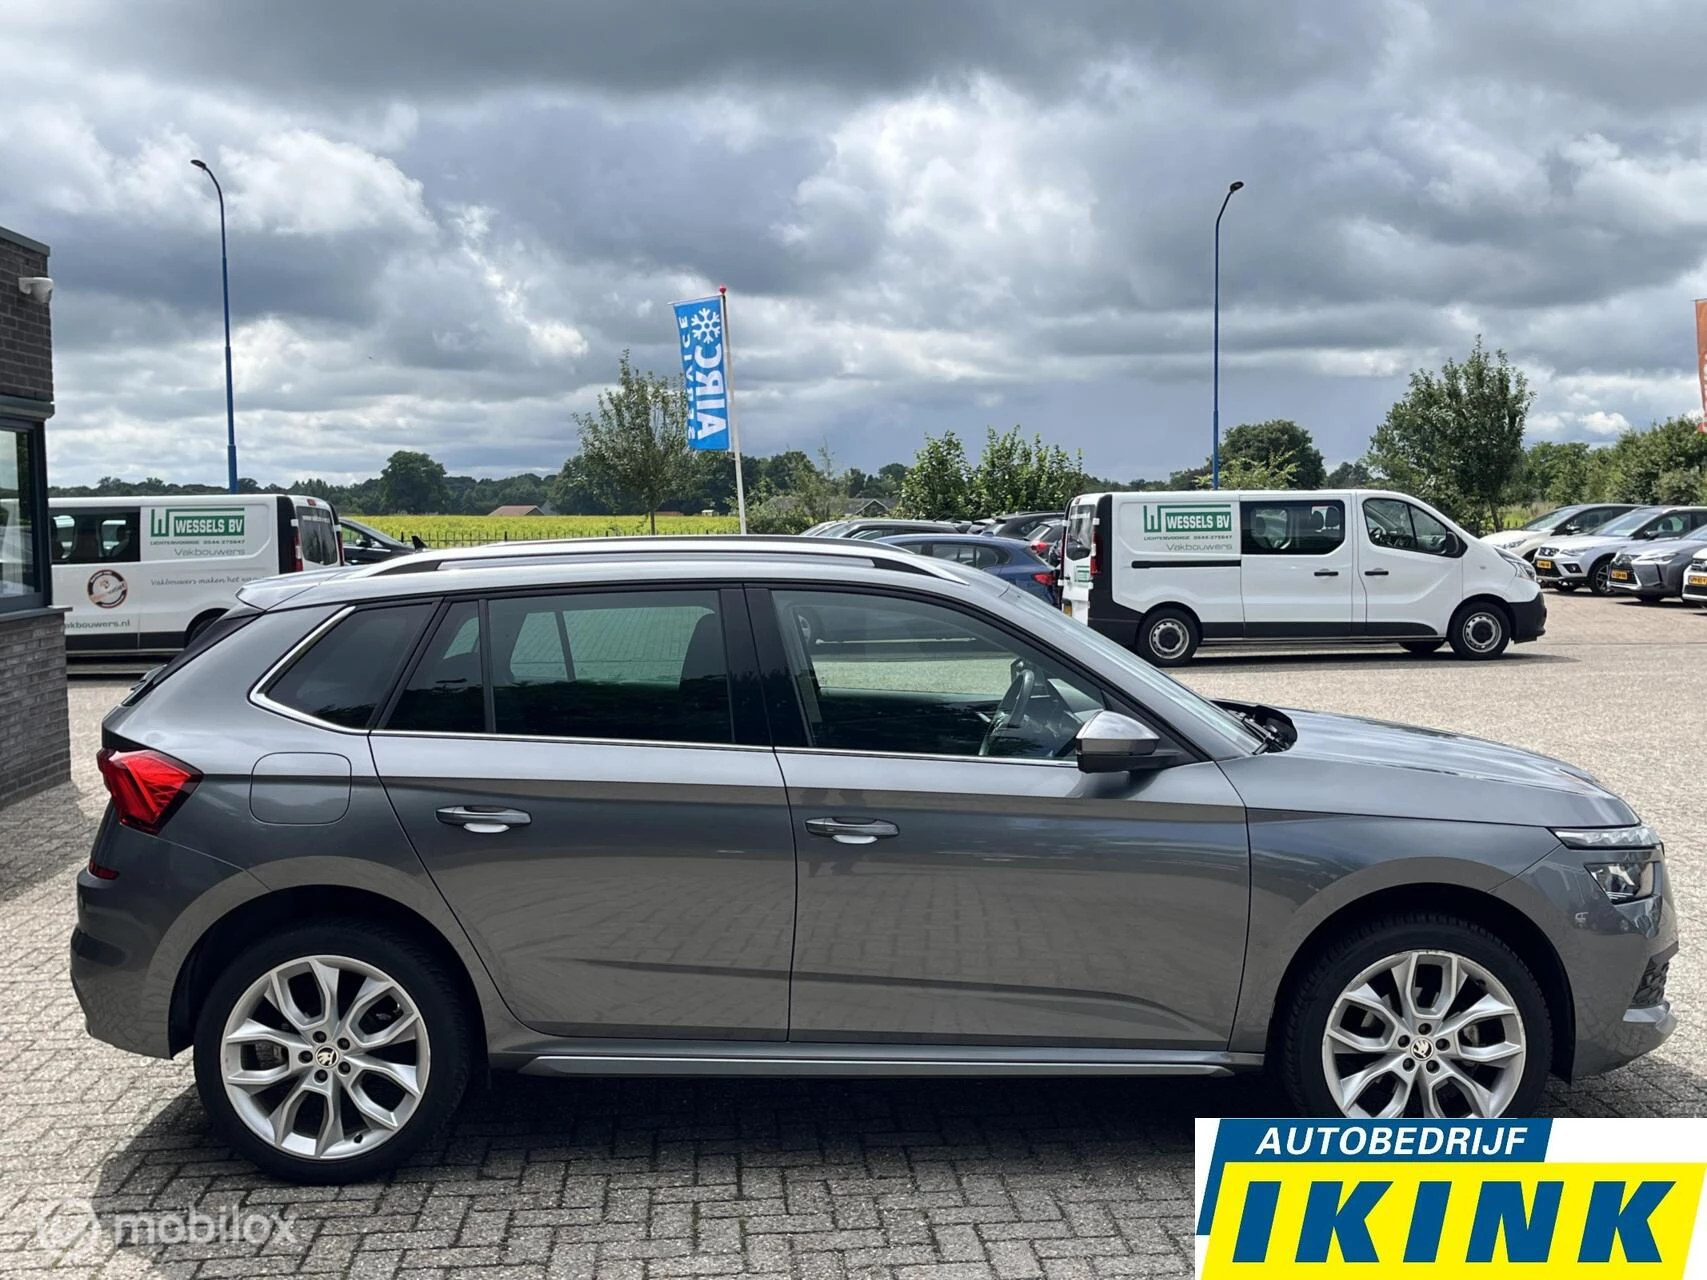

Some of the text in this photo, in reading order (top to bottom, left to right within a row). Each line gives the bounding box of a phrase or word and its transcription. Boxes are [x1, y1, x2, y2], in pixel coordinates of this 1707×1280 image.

[175, 518, 243, 534] WESSELS BV
[1166, 514, 1230, 529] WESSELS BV
[174, 547, 245, 556] Vakbouwers
[1166, 543, 1233, 551] Vakbouwers
[227, 575, 240, 583] het
